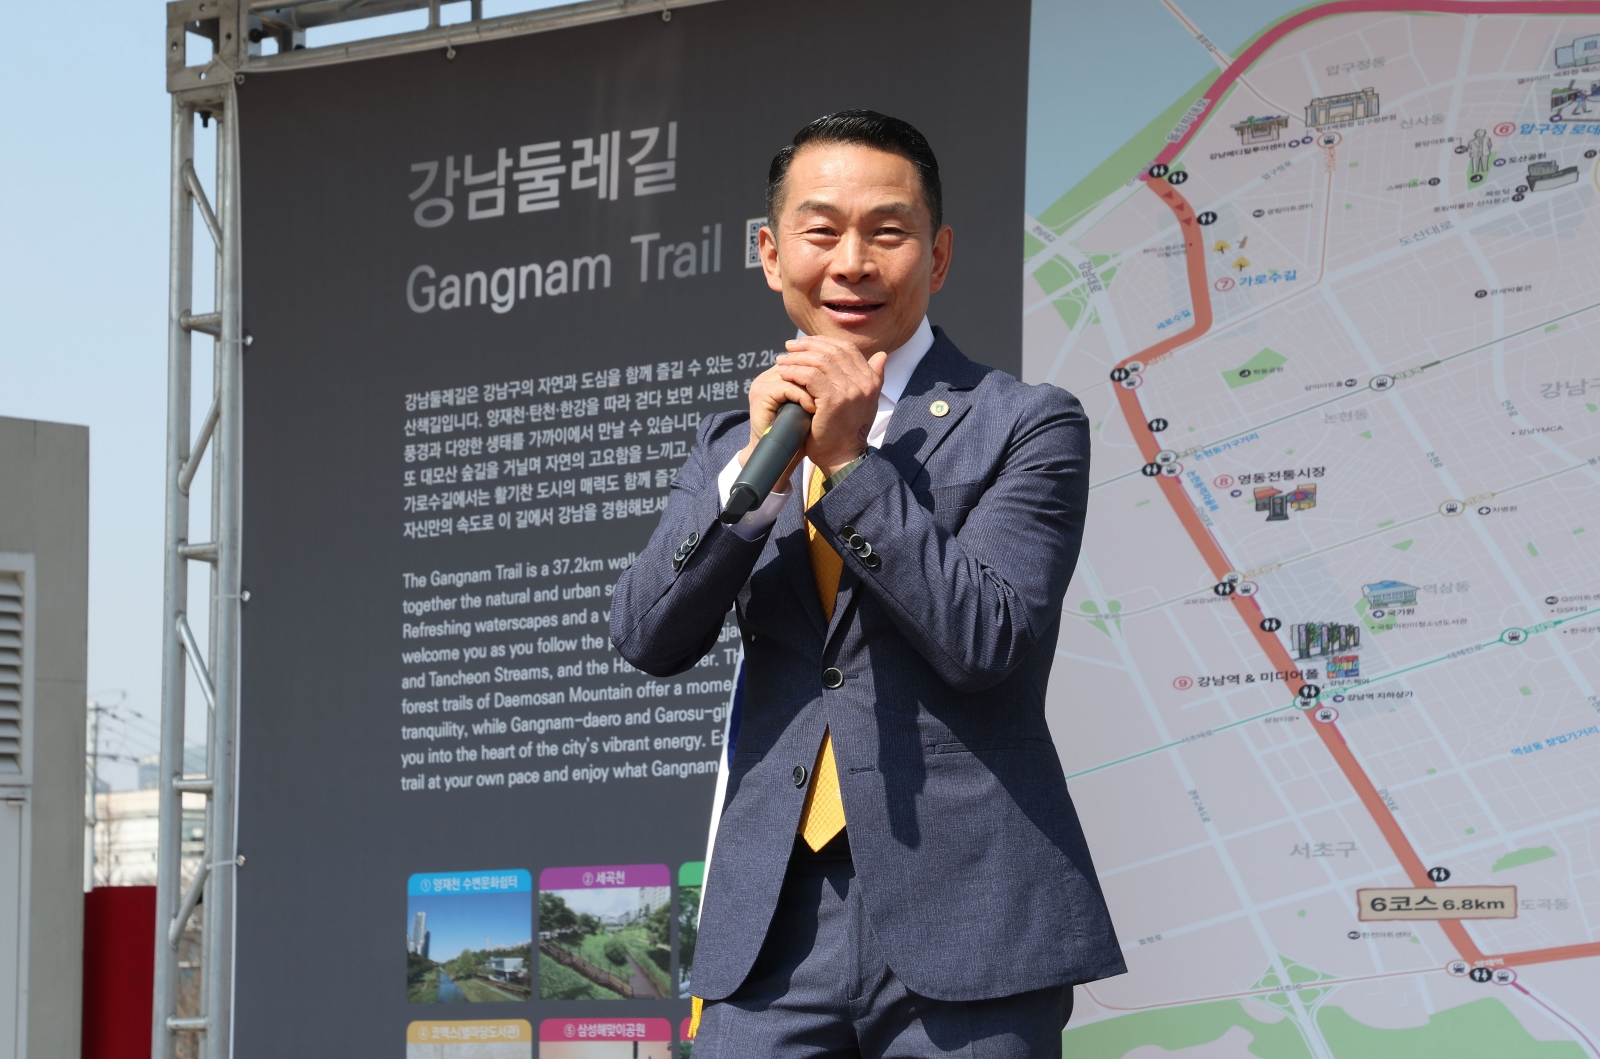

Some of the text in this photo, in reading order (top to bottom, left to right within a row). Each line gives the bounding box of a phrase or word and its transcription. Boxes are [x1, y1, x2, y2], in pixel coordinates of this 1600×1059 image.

[1326, 57, 1386, 76] 압구정동
[1399, 113, 1445, 130] 신사동
[1519, 124, 1567, 136] 압구정
[1508, 152, 1547, 165] 도산공원
[408, 121, 678, 228] 강남둘레길
[1399, 220, 1455, 247] 도산대로
[406, 223, 722, 314] Gangnam Trail
[1078, 259, 1103, 293] 강남대로
[1239, 269, 1297, 287] 가로수길
[1156, 309, 1192, 331] 세로수길
[405, 386, 479, 411] 강남둘레길은
[483, 379, 533, 402] 강남구의
[538, 374, 577, 394] 자연과
[581, 368, 621, 389] 도심을
[626, 364, 652, 384] 함께
[656, 361, 683, 381] 즐길
[688, 359, 701, 377] 수
[706, 355, 733, 375] 있는
[404, 412, 482, 436] 산책길입니다.
[604, 394, 631, 413] 따라
[635, 390, 662, 410] 걷다
[666, 386, 692, 405] 보면
[697, 380, 739, 401] 시원한
[1324, 408, 1369, 424] 논현동
[404, 412, 701, 462] 풍경과 다양한 생태를 가까이에서 만날 수 있습니다
[1518, 425, 1564, 436] 강남YMCA
[404, 470, 416, 486] 또
[421, 465, 458, 485] 대모산
[461, 461, 499, 482] 숲길을
[503, 456, 541, 476] 거닐며
[545, 451, 584, 472] 자연의
[589, 445, 642, 466] 고요함을
[1238, 466, 1327, 486] 영동전통시장
[404, 471, 650, 513] 가로수길에서는 활기찬 도시의 매력도 함께
[403, 518, 452, 539] 자신만의
[456, 514, 494, 533] 속도로
[498, 512, 510, 529] 이
[516, 507, 553, 528] 길에서
[558, 503, 597, 524] 강남을
[403, 557, 603, 588] The Gangnam Trail is a 37.2km
[403, 596, 457, 616] together
[460, 593, 482, 609] the
[486, 588, 530, 606] natural
[534, 585, 558, 602] and
[563, 583, 600, 600] urban
[1423, 582, 1470, 596] 역삼동
[403, 620, 471, 638] Refreshing
[475, 615, 558, 632] waterscapes
[562, 608, 587, 626] and
[591, 612, 599, 623] a
[1387, 608, 1415, 617] 국기원
[402, 647, 460, 663] welcome
[463, 647, 486, 662] you
[490, 645, 506, 657] as
[509, 643, 533, 659] you
[537, 636, 577, 653] follow
[581, 634, 603, 650] the
[402, 672, 425, 689] and
[429, 670, 490, 687] Tancheon
[494, 666, 553, 682] Streams,
[557, 660, 582, 677] and
[586, 659, 609, 675] the
[1197, 668, 1319, 688] 강남역 & 미디어폴
[401, 681, 682, 714] forest trails of Daemosan Mountain offer a
[1377, 690, 1413, 701] 지하상가
[401, 721, 468, 741] tranquility,
[472, 718, 507, 735] while
[511, 712, 621, 734] Gangnam-daero
[625, 708, 650, 725] and
[401, 753, 424, 768] you
[428, 748, 452, 763] into
[456, 746, 477, 762] the
[481, 745, 515, 760] heart
[519, 741, 533, 758] of
[536, 741, 558, 757] the
[602, 736, 650, 752] vibrant
[654, 735, 706, 751] energy.
[1511, 725, 1600, 755] 역삼동 창업가거리
[401, 760, 718, 791] trail at your own pace and enjoy what Gangnam
[1289, 841, 1357, 859] 서초구
[433, 877, 461, 892] 양재천
[595, 871, 626, 886] 세곡천
[1370, 896, 1505, 912] 6코스 6.8km
[1520, 898, 1570, 911] 도곡동
[577, 1023, 646, 1038] 삼성해맞이공원
